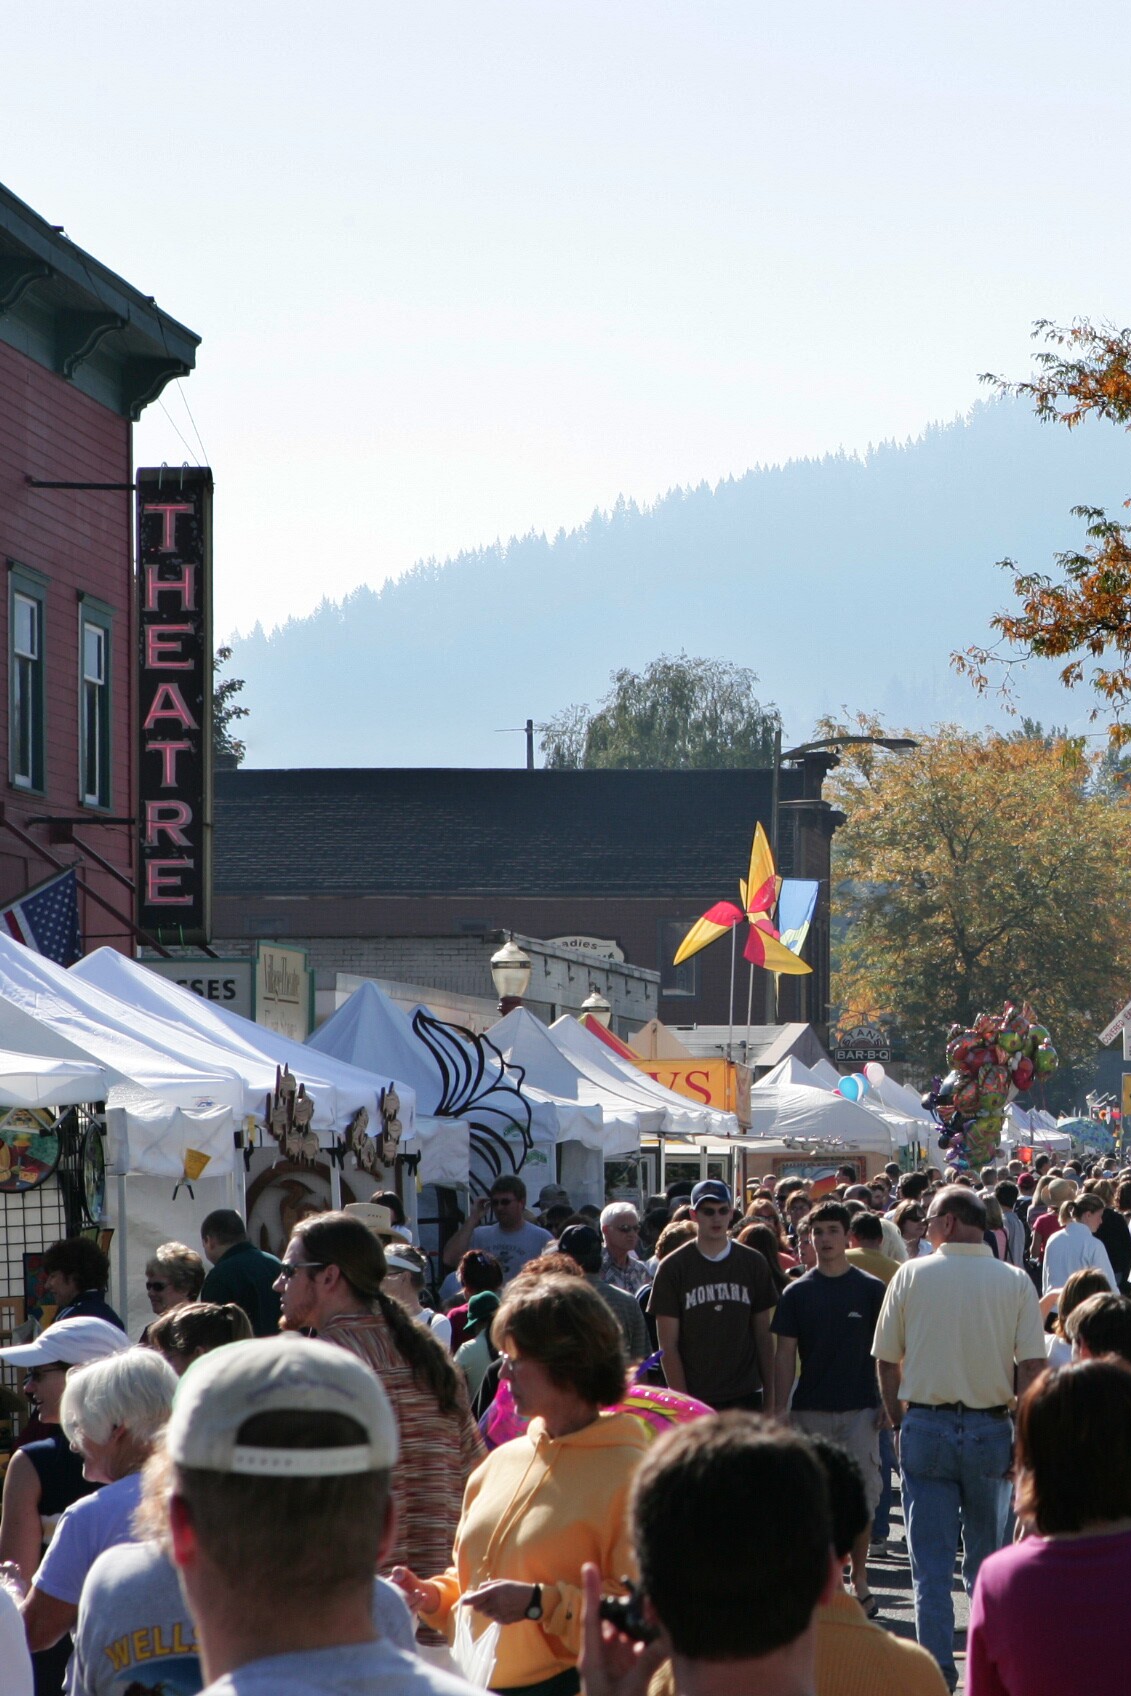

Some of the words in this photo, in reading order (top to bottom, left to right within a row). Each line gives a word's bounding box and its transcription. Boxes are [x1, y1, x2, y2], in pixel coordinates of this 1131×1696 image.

[142, 503, 200, 906] THEATRE
[843, 1029, 881, 1046] STAN'S
[1102, 1020, 1125, 1044] COVERED
[837, 1050, 889, 1060] BAR-B-Q
[685, 1282, 751, 1310] MONTANA
